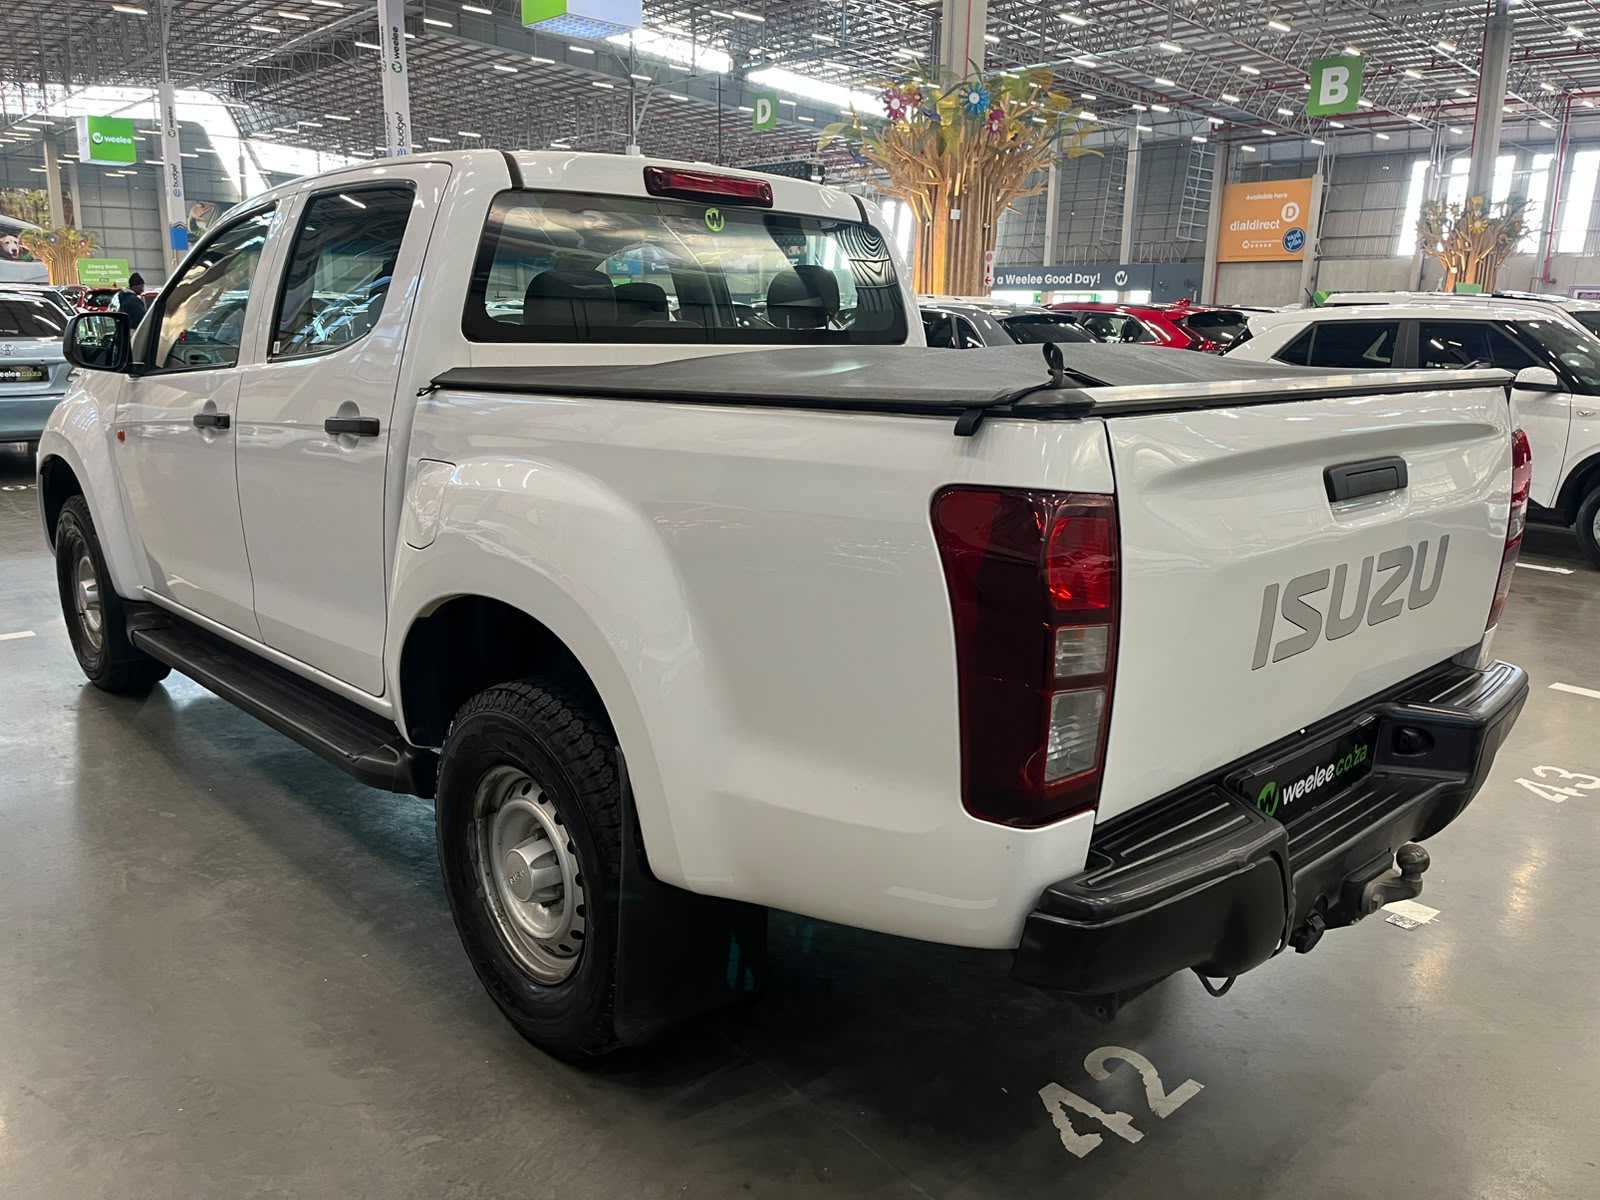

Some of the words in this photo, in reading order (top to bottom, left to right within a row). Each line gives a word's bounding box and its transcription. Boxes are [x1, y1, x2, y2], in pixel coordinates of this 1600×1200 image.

[392, 26, 400, 59] weelee
[1319, 66, 1350, 106] B
[167, 105, 175, 128] weelee
[756, 98, 772, 125] D
[103, 135, 133, 144] weelee
[395, 112, 407, 147] budget
[171, 163, 180, 188] budget
[1245, 193, 1273, 201] Available
[1230, 219, 1280, 231] dialdirect
[996, 275, 1004, 285] a
[1005, 273, 1043, 285] Weelee
[1044, 273, 1073, 285] Good
[1074, 273, 1101, 287] Day!
[1252, 534, 1450, 671] ISUZU
[1282, 743, 1368, 806] weelee.co.za
[1514, 765, 1600, 803] 43
[1038, 1045, 1205, 1159] 42
